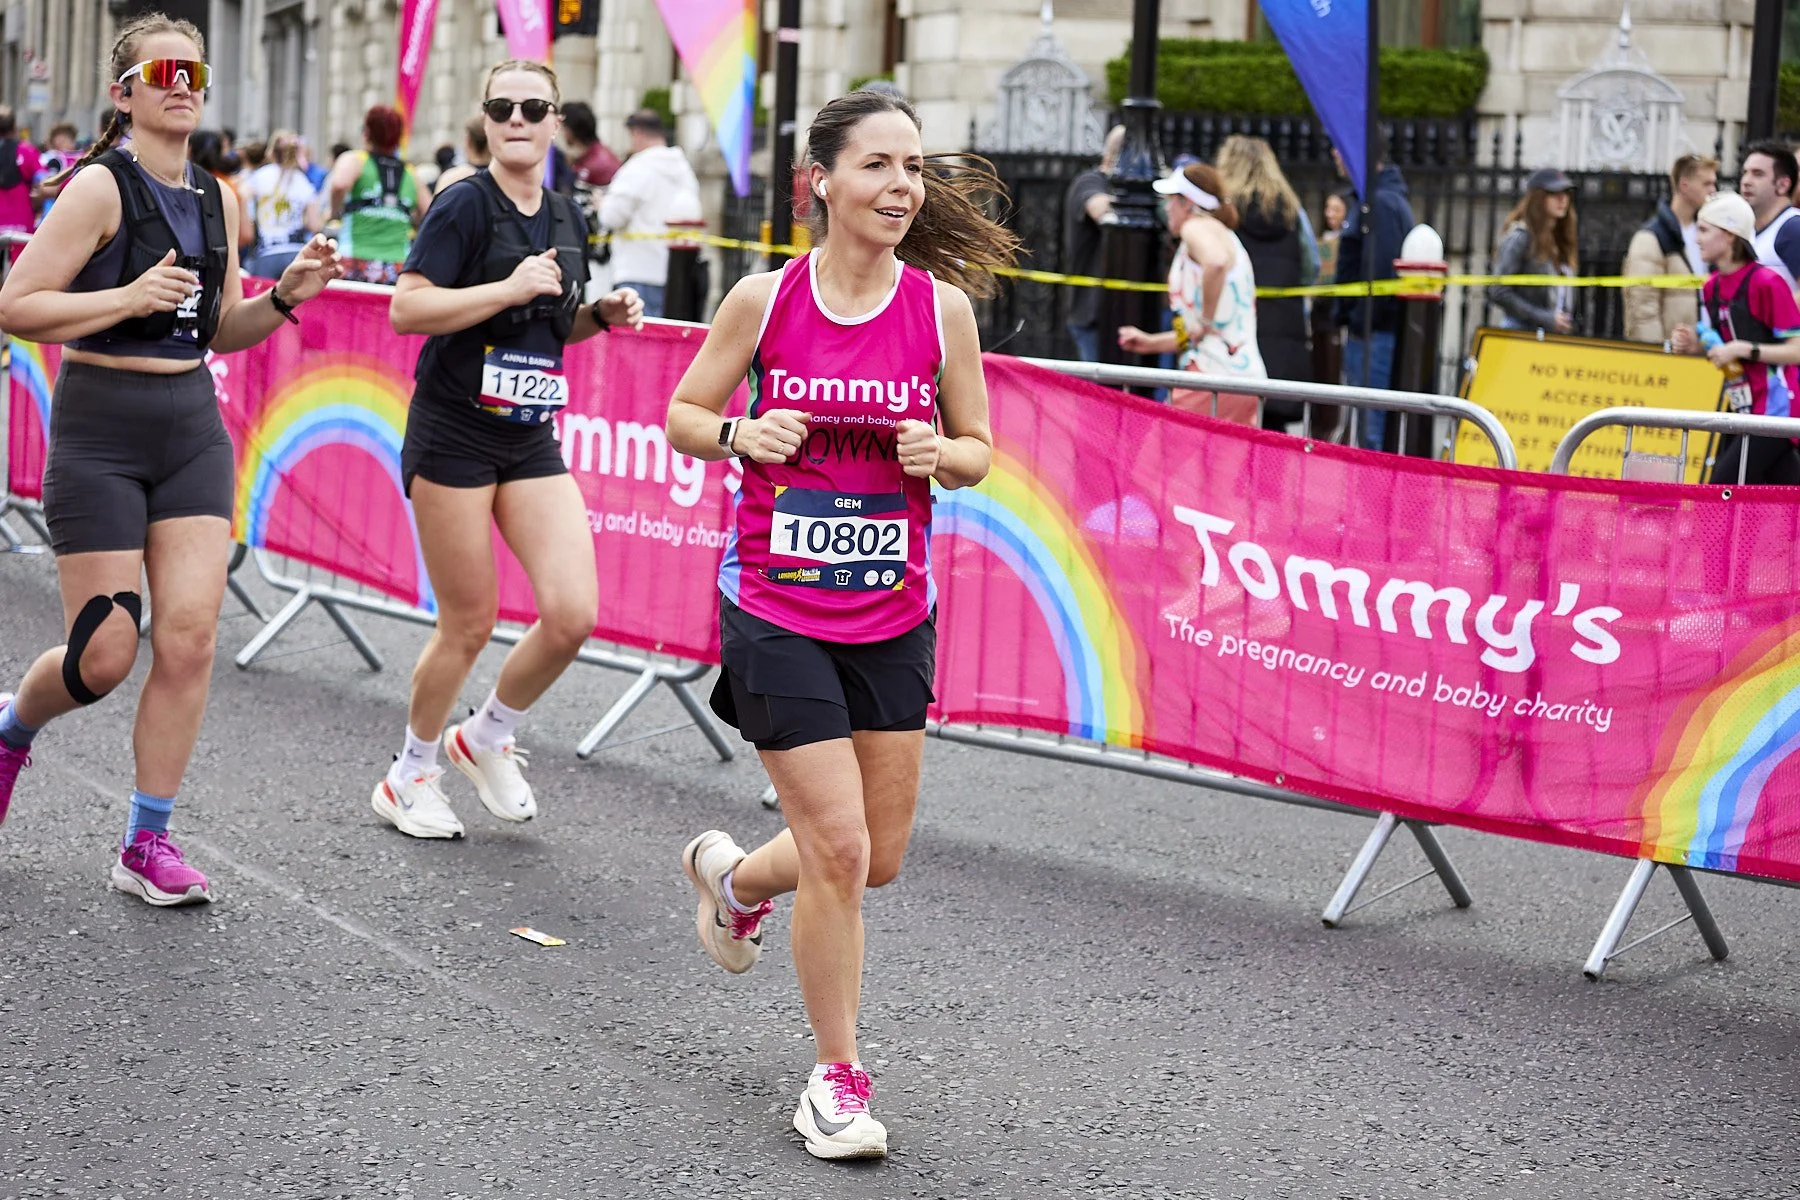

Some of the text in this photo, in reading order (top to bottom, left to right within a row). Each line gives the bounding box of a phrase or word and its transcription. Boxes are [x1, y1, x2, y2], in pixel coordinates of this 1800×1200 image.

[492, 371, 562, 400] 11222
[769, 369, 931, 413] Tommy's
[1529, 363, 1670, 389] NO VEHICULAR
[1541, 388, 1615, 408] ACCESS
[843, 415, 865, 424] and
[868, 416, 896, 428] baby
[834, 497, 862, 509] GEM
[604, 510, 638, 535] and
[639, 511, 684, 547] baby
[686, 521, 734, 548] chari
[784, 519, 901, 556] 10802
[1173, 505, 1622, 673] Tommy's
[1164, 613, 1613, 733] The pregnancy and baby charity
